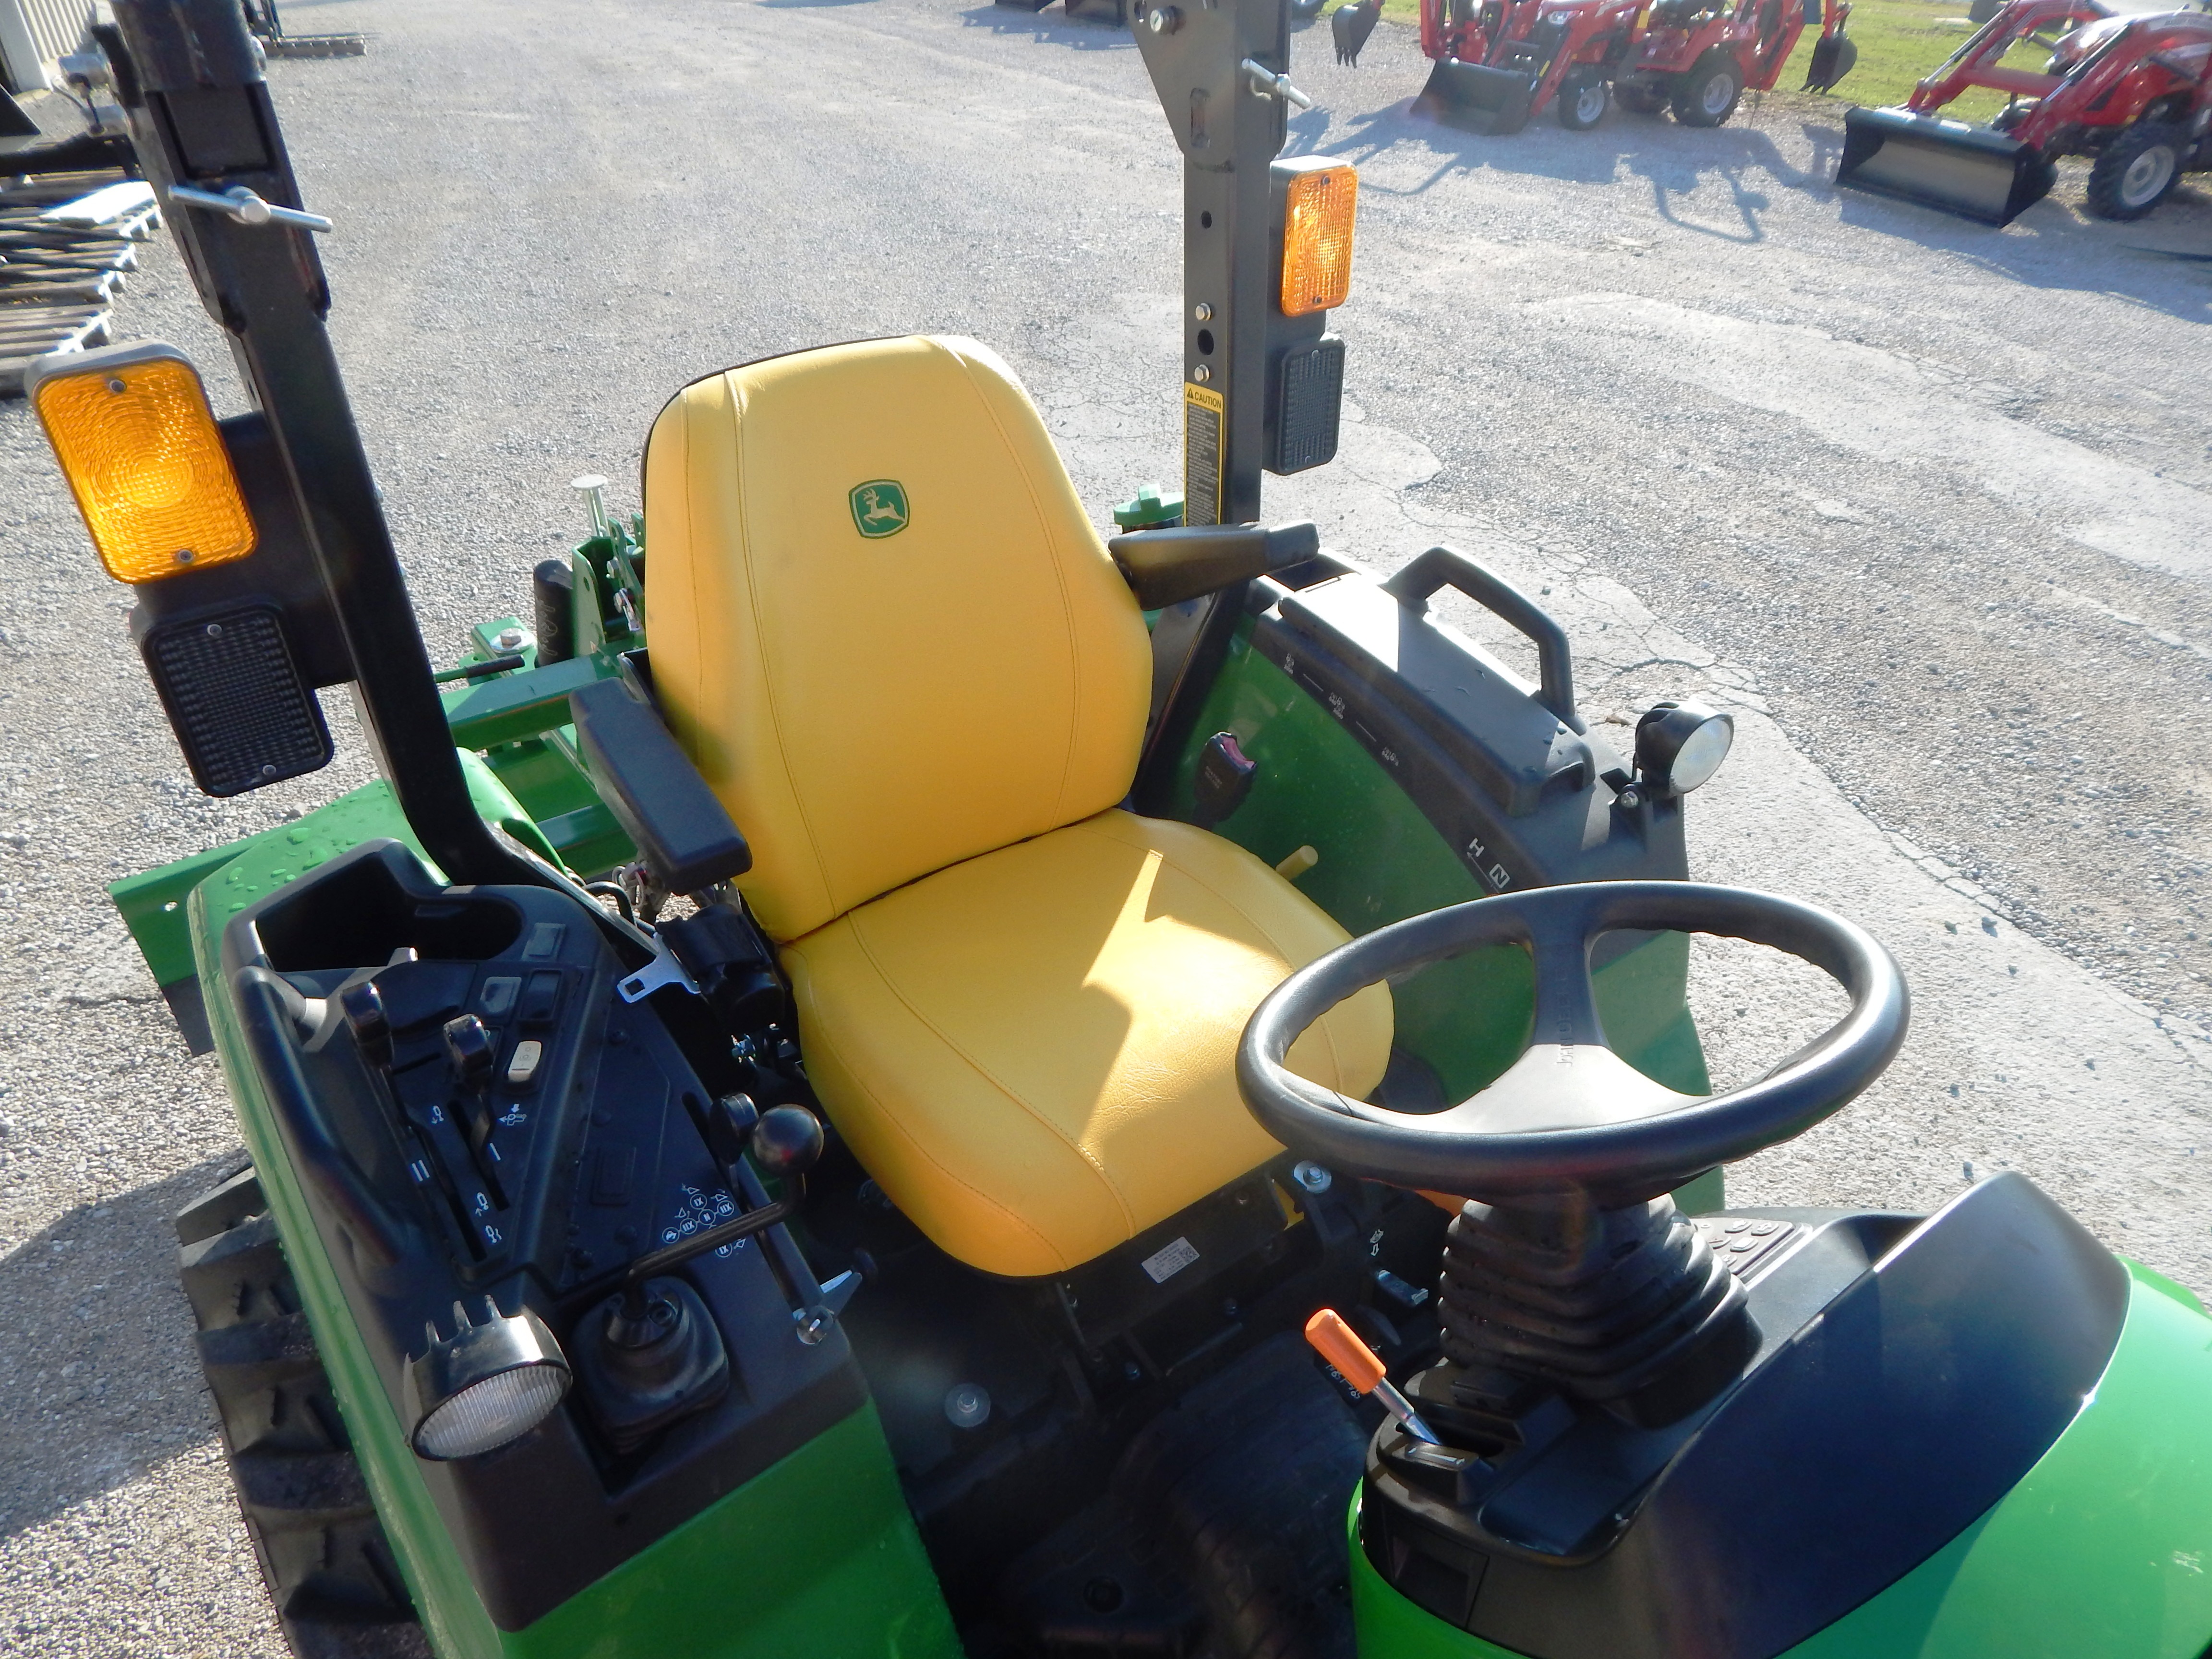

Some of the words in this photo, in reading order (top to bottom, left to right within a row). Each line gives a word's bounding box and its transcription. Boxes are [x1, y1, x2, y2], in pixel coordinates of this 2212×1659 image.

[1194, 391, 1222, 409] CAUTION
[1469, 837, 1485, 857] H
[1491, 866, 1509, 887] N
